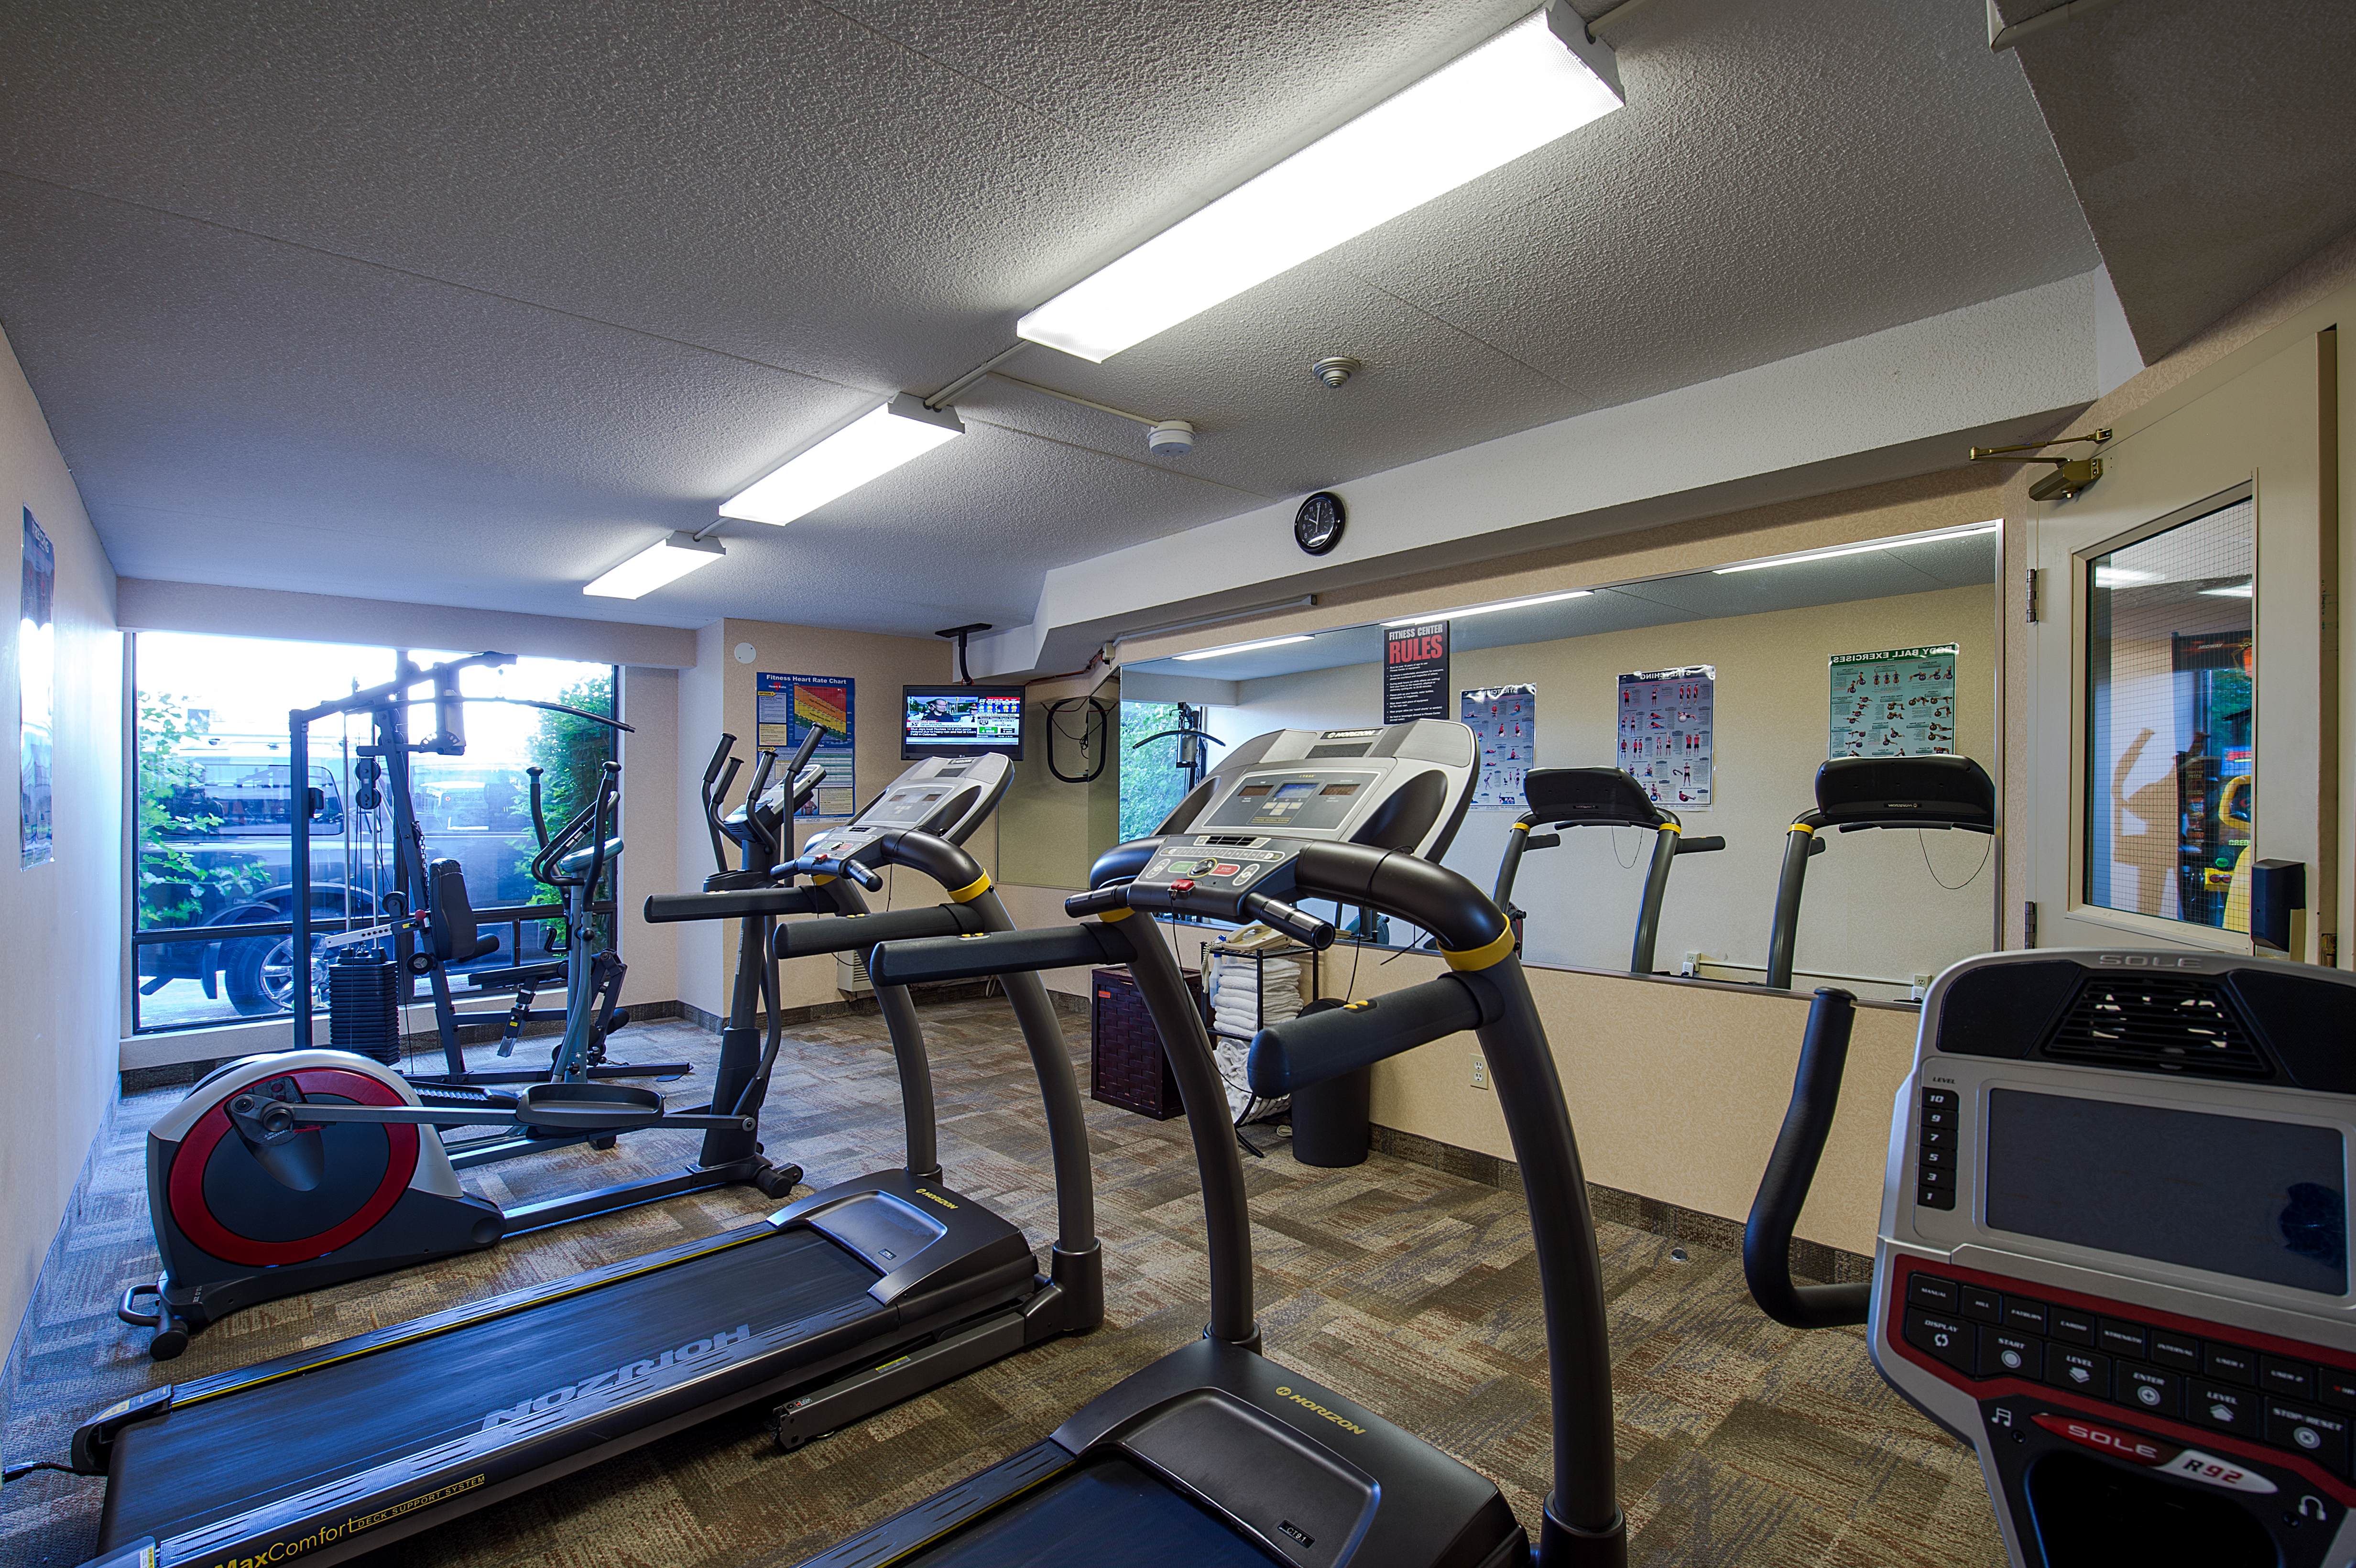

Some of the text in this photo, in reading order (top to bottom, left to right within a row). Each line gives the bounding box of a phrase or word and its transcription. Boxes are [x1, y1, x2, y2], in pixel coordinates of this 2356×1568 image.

[1389, 624, 1443, 641] FITNESS CENTER
[1389, 635, 1443, 664] RULES
[2099, 955, 2203, 969] SOLE
[1930, 1095, 1944, 1103] 10
[1931, 1114, 1941, 1122] 9
[1927, 1173, 1937, 1181] 3
[922, 1191, 959, 1209] HORIZON
[1921, 1287, 1947, 1298] MANUAL
[2011, 1309, 2042, 1321] FATBURN
[1924, 1319, 1959, 1333] DISPLAY
[1998, 1337, 2026, 1350] START
[2104, 1330, 2142, 1344] STRENGTH
[2066, 1355, 2094, 1368] LEVEL
[481, 1324, 750, 1431] HORIZON
[2133, 1372, 2165, 1385] ENTER
[2206, 1391, 2238, 1405] LEVEL
[1288, 1394, 1366, 1435] HORIZON
[2273, 1407, 2343, 1431] STOP/RESET
[2068, 1424, 2244, 1484] SOLE R92
[215, 1476, 485, 1568] MaxComfort DECK SUPPORT SYSTEM
[1287, 1527, 1307, 1543] CT9.1
